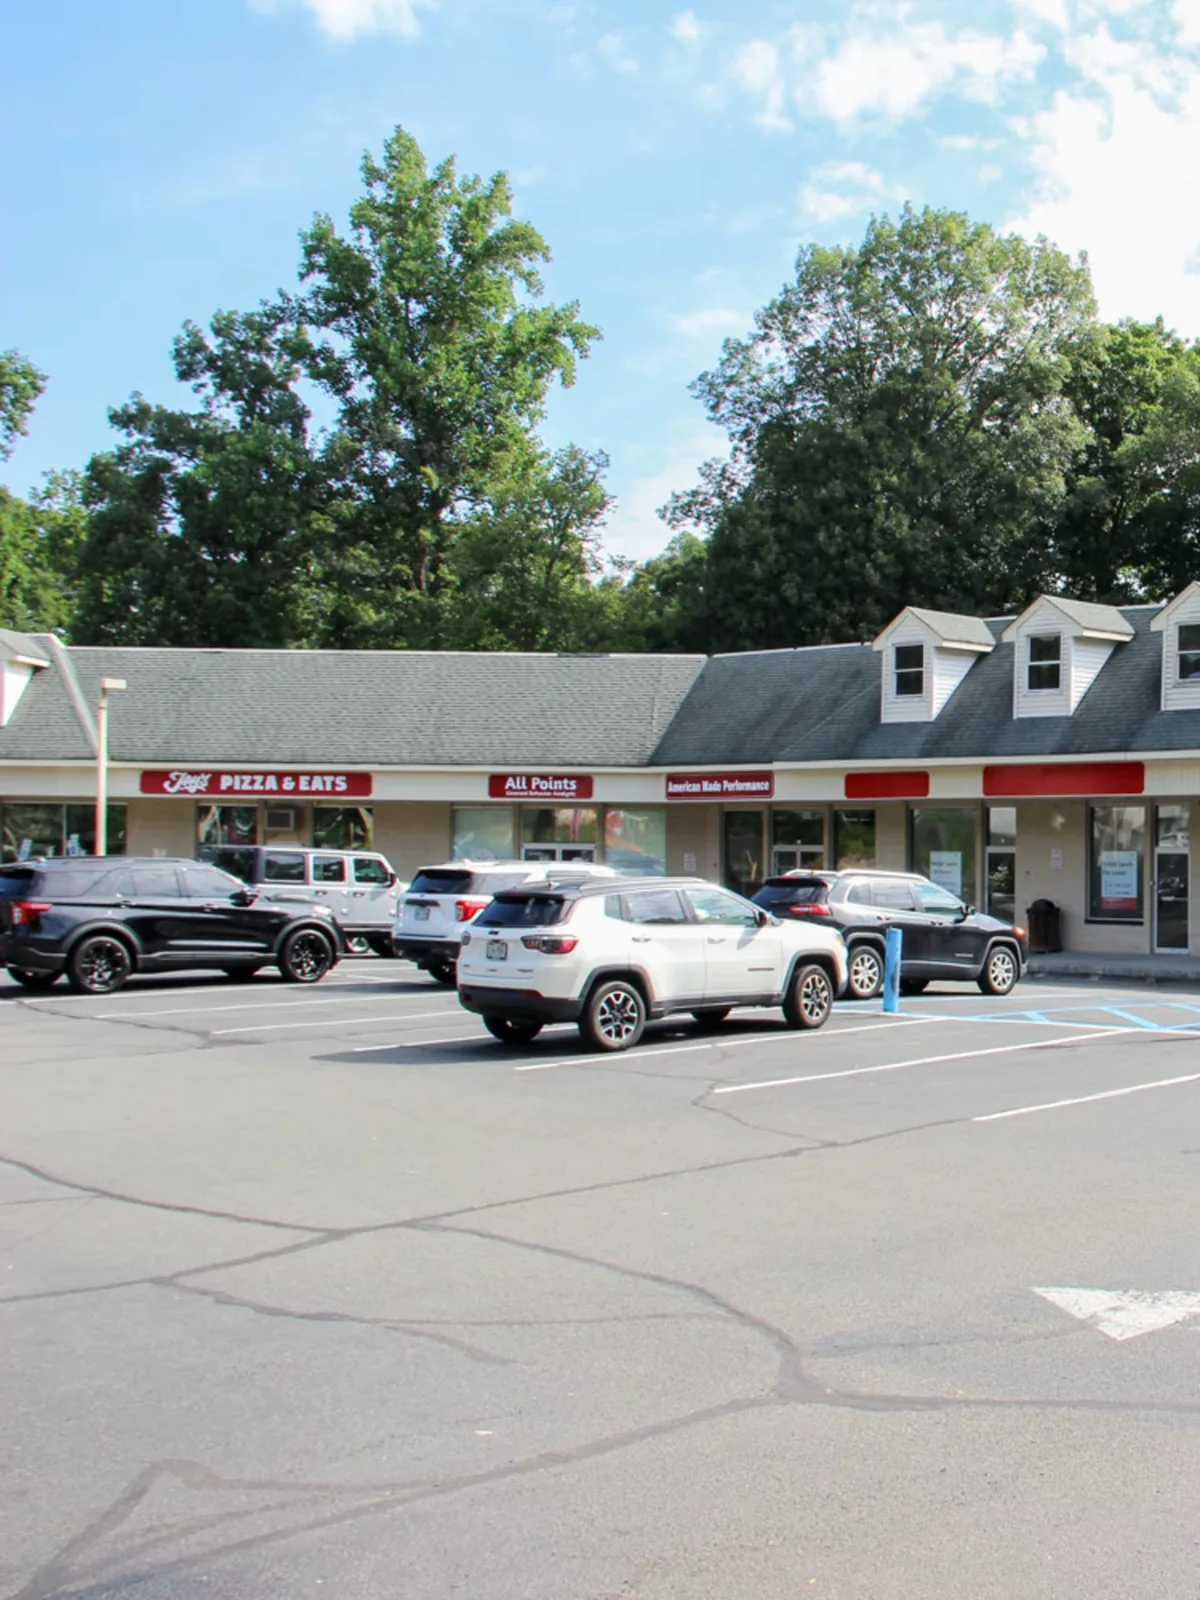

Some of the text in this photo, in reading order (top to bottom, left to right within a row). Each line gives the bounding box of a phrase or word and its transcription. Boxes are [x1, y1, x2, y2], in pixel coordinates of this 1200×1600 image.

[220, 775, 278, 790] PIZZA
[282, 776, 296, 791] &
[299, 775, 348, 791] EATS
[504, 776, 577, 790] All Points
[668, 780, 701, 792] American
[723, 779, 770, 791] Performance
